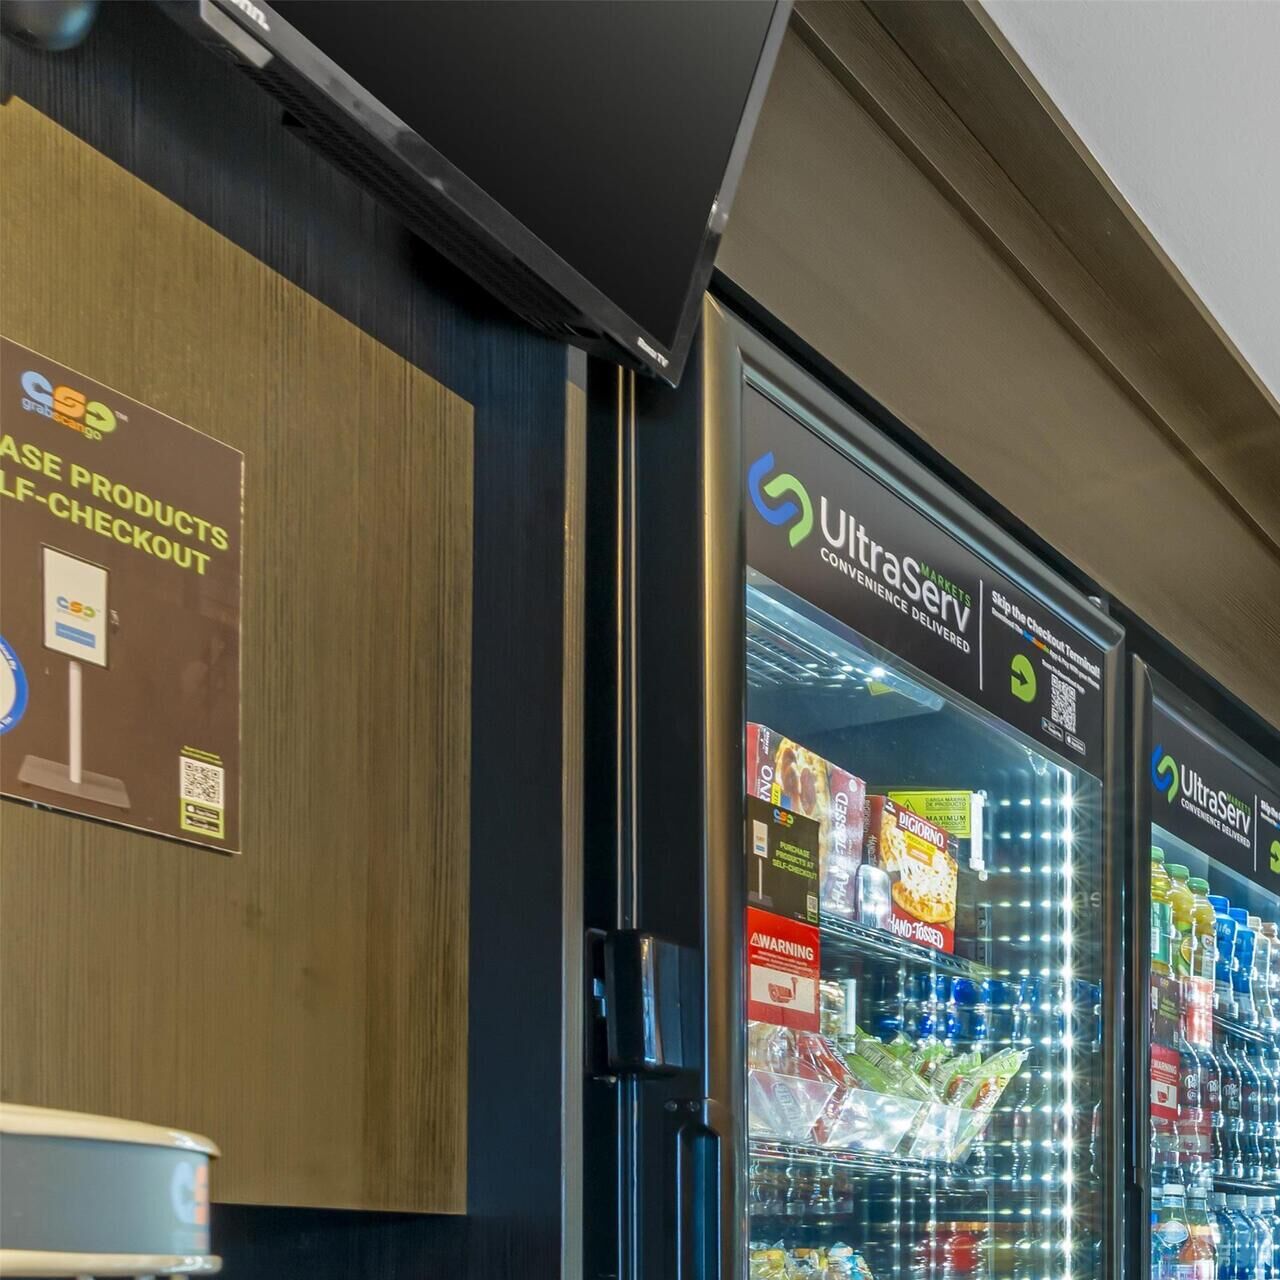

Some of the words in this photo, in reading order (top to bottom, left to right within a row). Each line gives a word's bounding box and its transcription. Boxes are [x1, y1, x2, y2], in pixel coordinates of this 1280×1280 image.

[70, 463, 230, 551] PRODUCTS
[820, 495, 971, 634] UltraServ
[920, 561, 972, 607] MARKETS
[820, 547, 909, 614] CONVENIENCE
[911, 605, 971, 655] DELIVERED
[992, 590, 1011, 616] Skip
[1012, 603, 1027, 624] the
[1026, 615, 1066, 655] Checkout
[899, 812, 945, 849] DIGIORNO
[1181, 764, 1250, 836] UltraServ
[759, 933, 815, 961] WARNING
[890, 914, 944, 950] HAND-TOSSED
